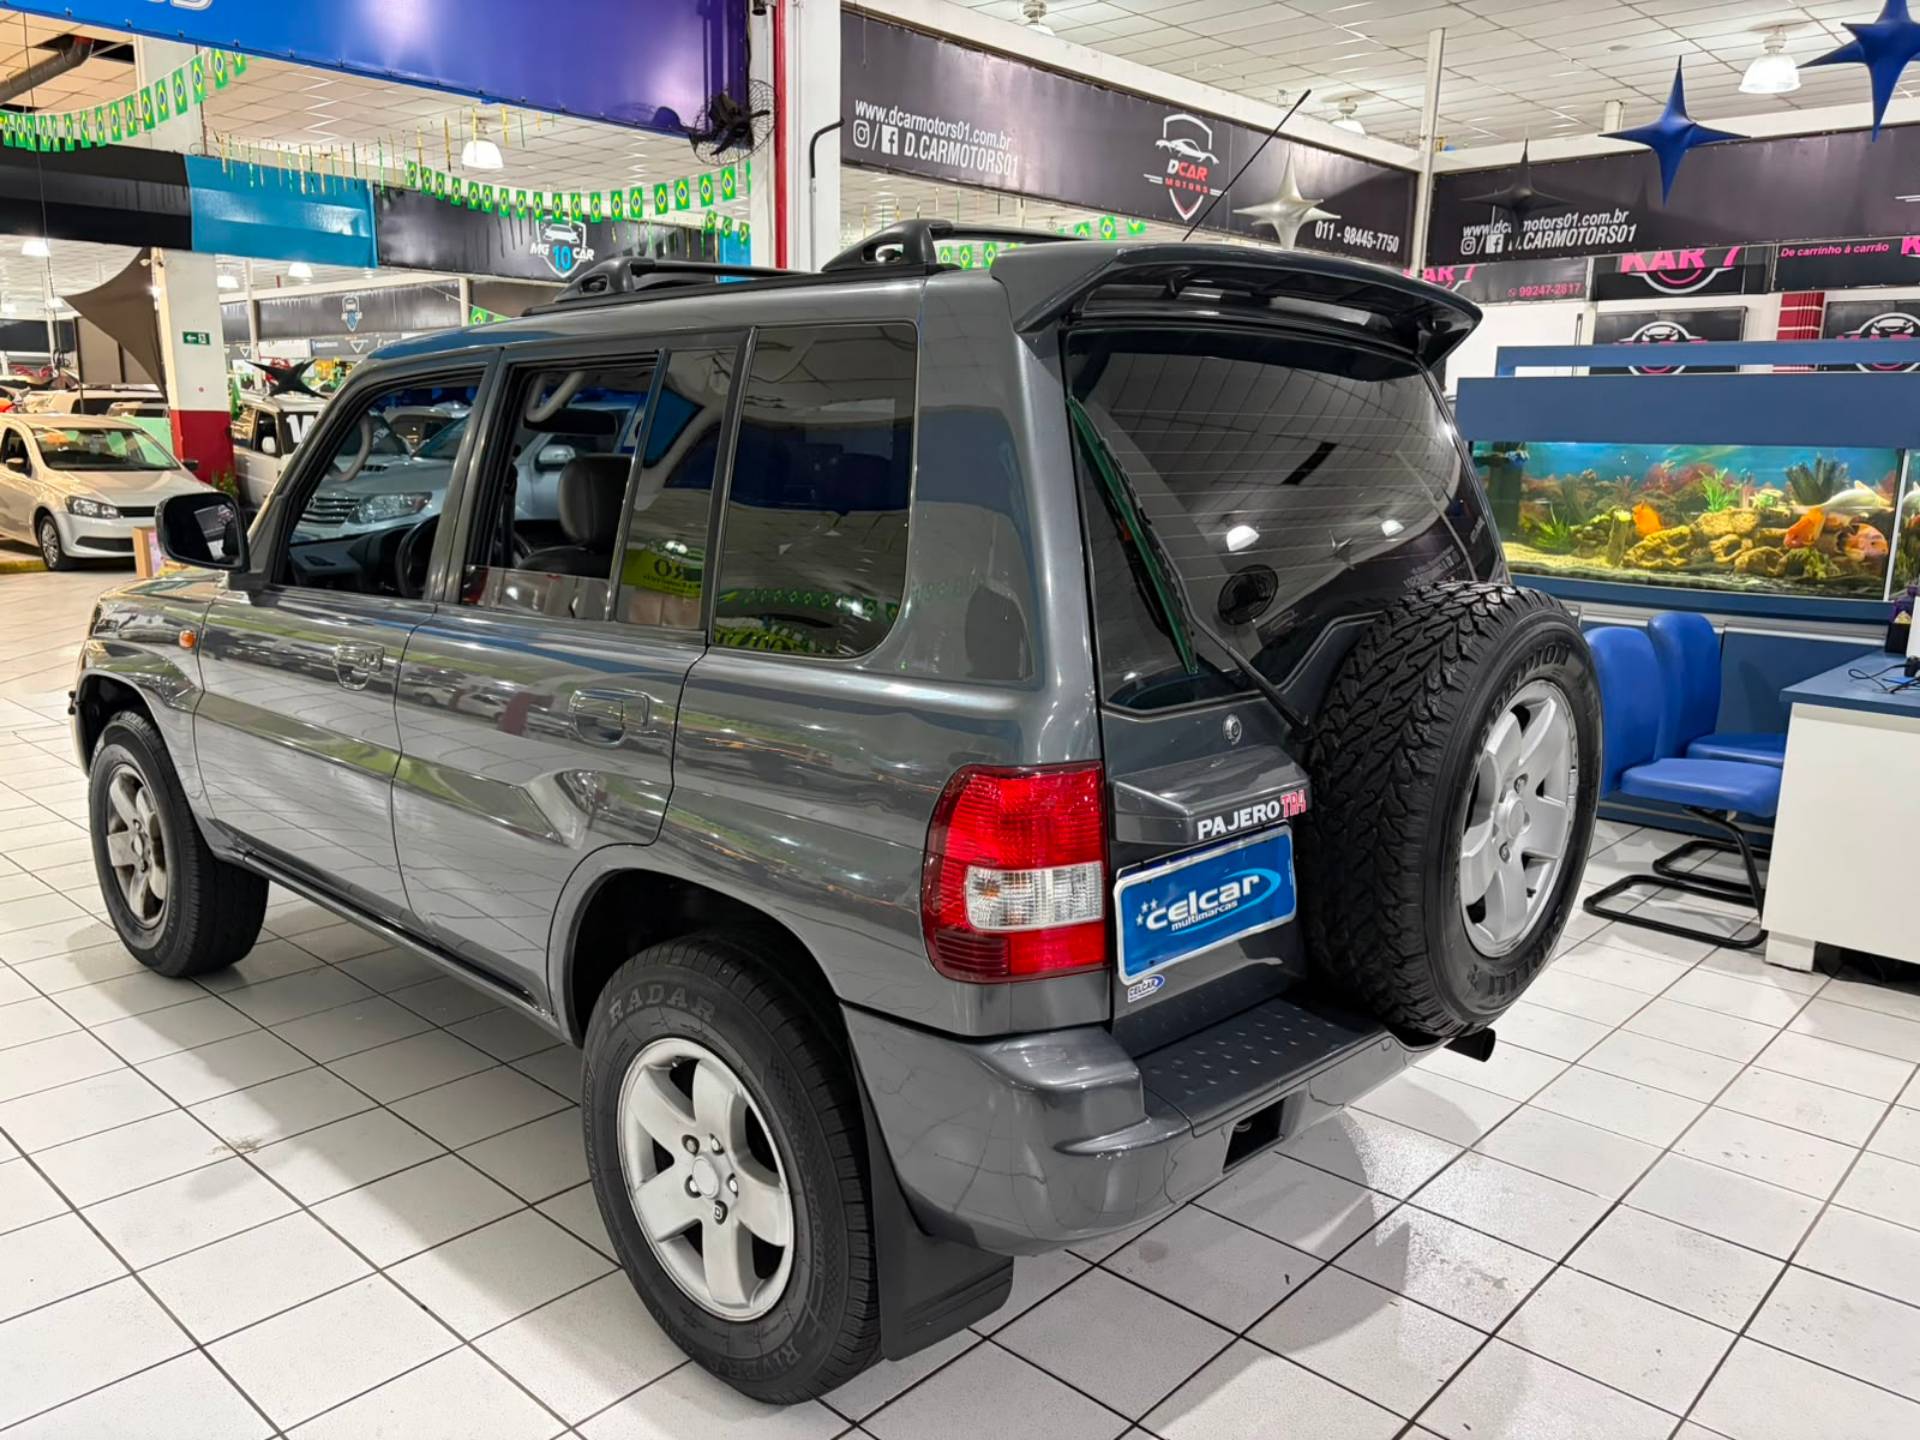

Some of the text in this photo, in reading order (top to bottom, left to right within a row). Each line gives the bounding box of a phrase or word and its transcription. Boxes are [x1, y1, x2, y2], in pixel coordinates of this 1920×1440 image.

[855, 100, 1012, 150] www.dcarmotors01.com.br
[904, 132, 1018, 176] D.CARMOTORS01
[1165, 177, 1208, 194] MOTORS
[1167, 159, 1208, 181] DCAR
[1315, 221, 1334, 241] 011
[1344, 226, 1399, 253] 98445-7750
[1508, 224, 1637, 251] .CARMOTORS01
[1781, 246, 1795, 257] De
[1797, 245, 1841, 256] carrinho
[553, 245, 573, 272] 10
[572, 247, 595, 261] CAR
[1197, 800, 1280, 840] PAJERO
[1146, 874, 1260, 931] celcar
[1172, 900, 1238, 931] multimarcas
[609, 984, 715, 1029] RADAR
